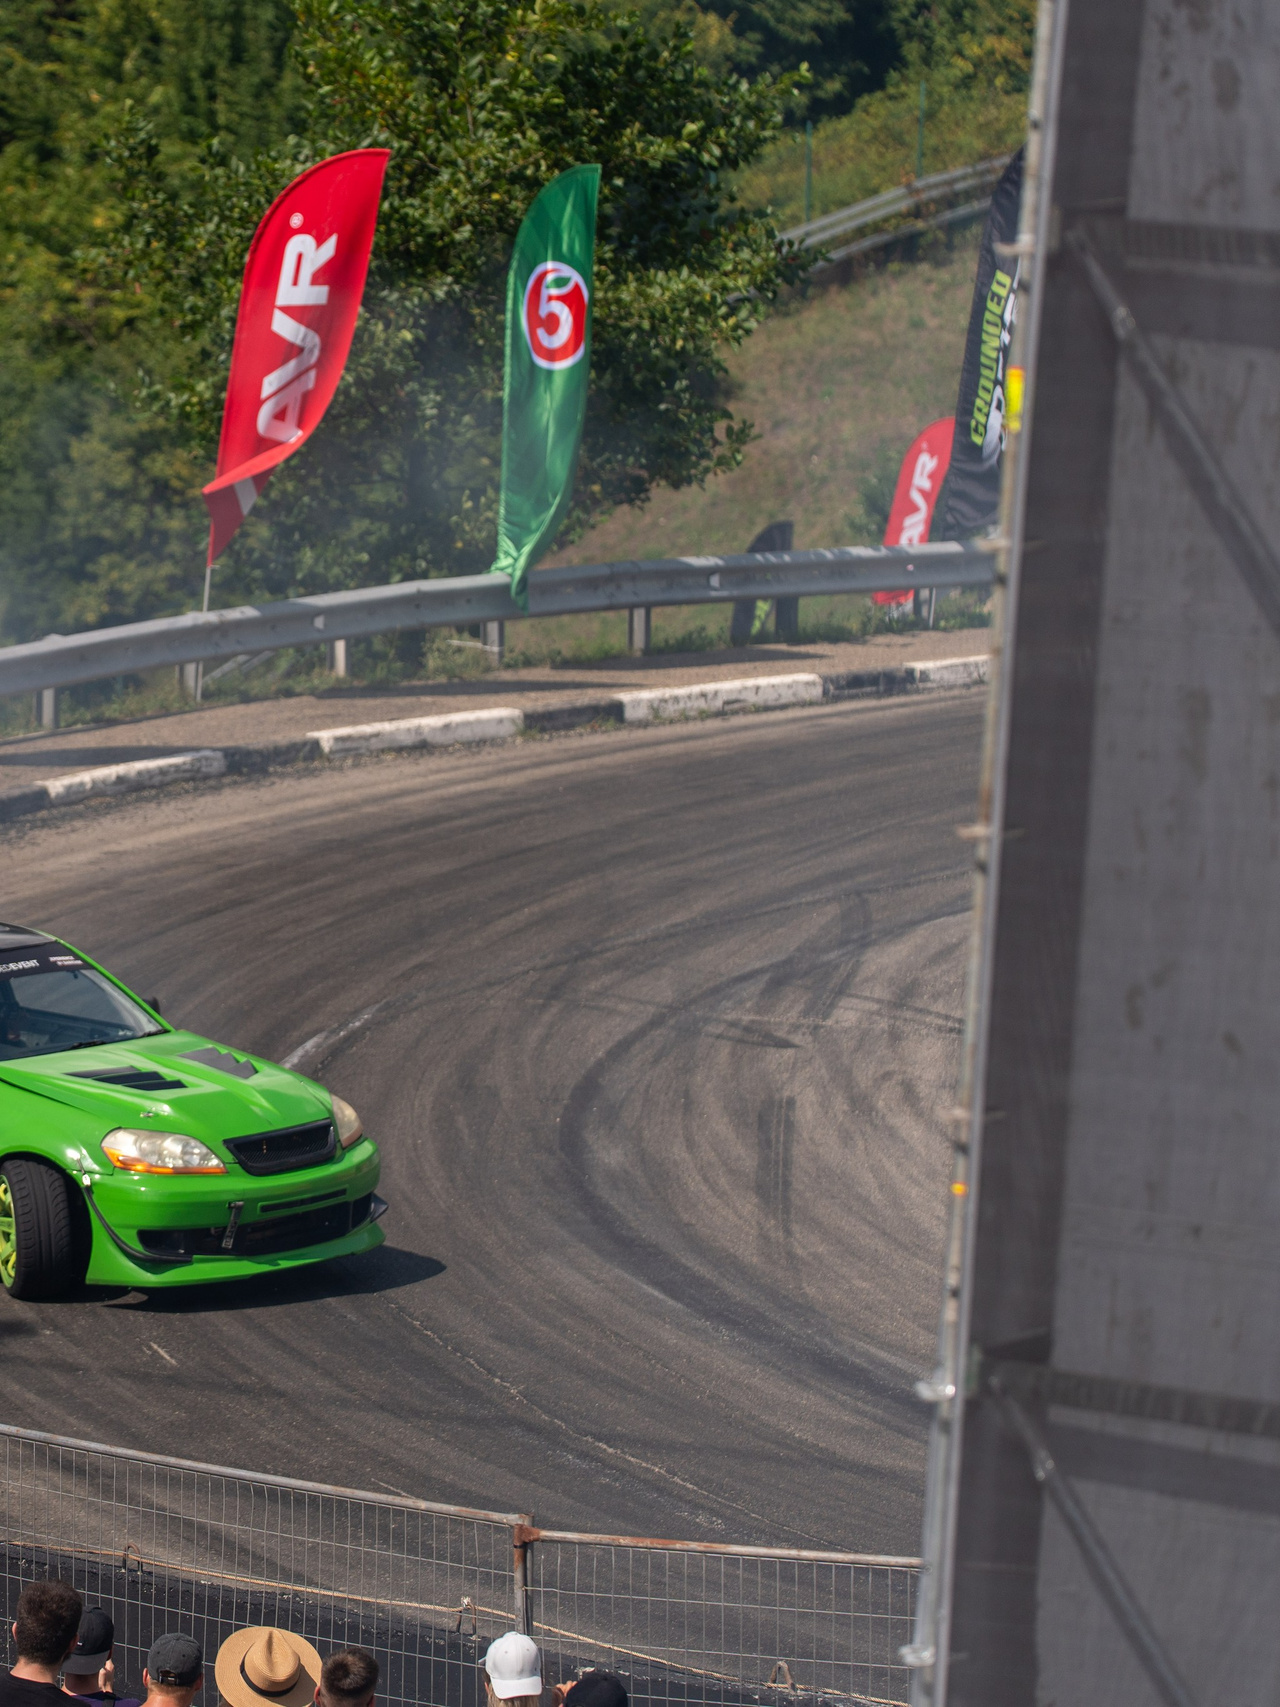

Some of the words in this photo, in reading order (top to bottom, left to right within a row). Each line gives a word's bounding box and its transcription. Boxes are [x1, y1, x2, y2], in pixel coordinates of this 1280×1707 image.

[256, 233, 338, 444] AVR
[970, 269, 1012, 447] GROUNDED
[899, 451, 939, 545] AVR
